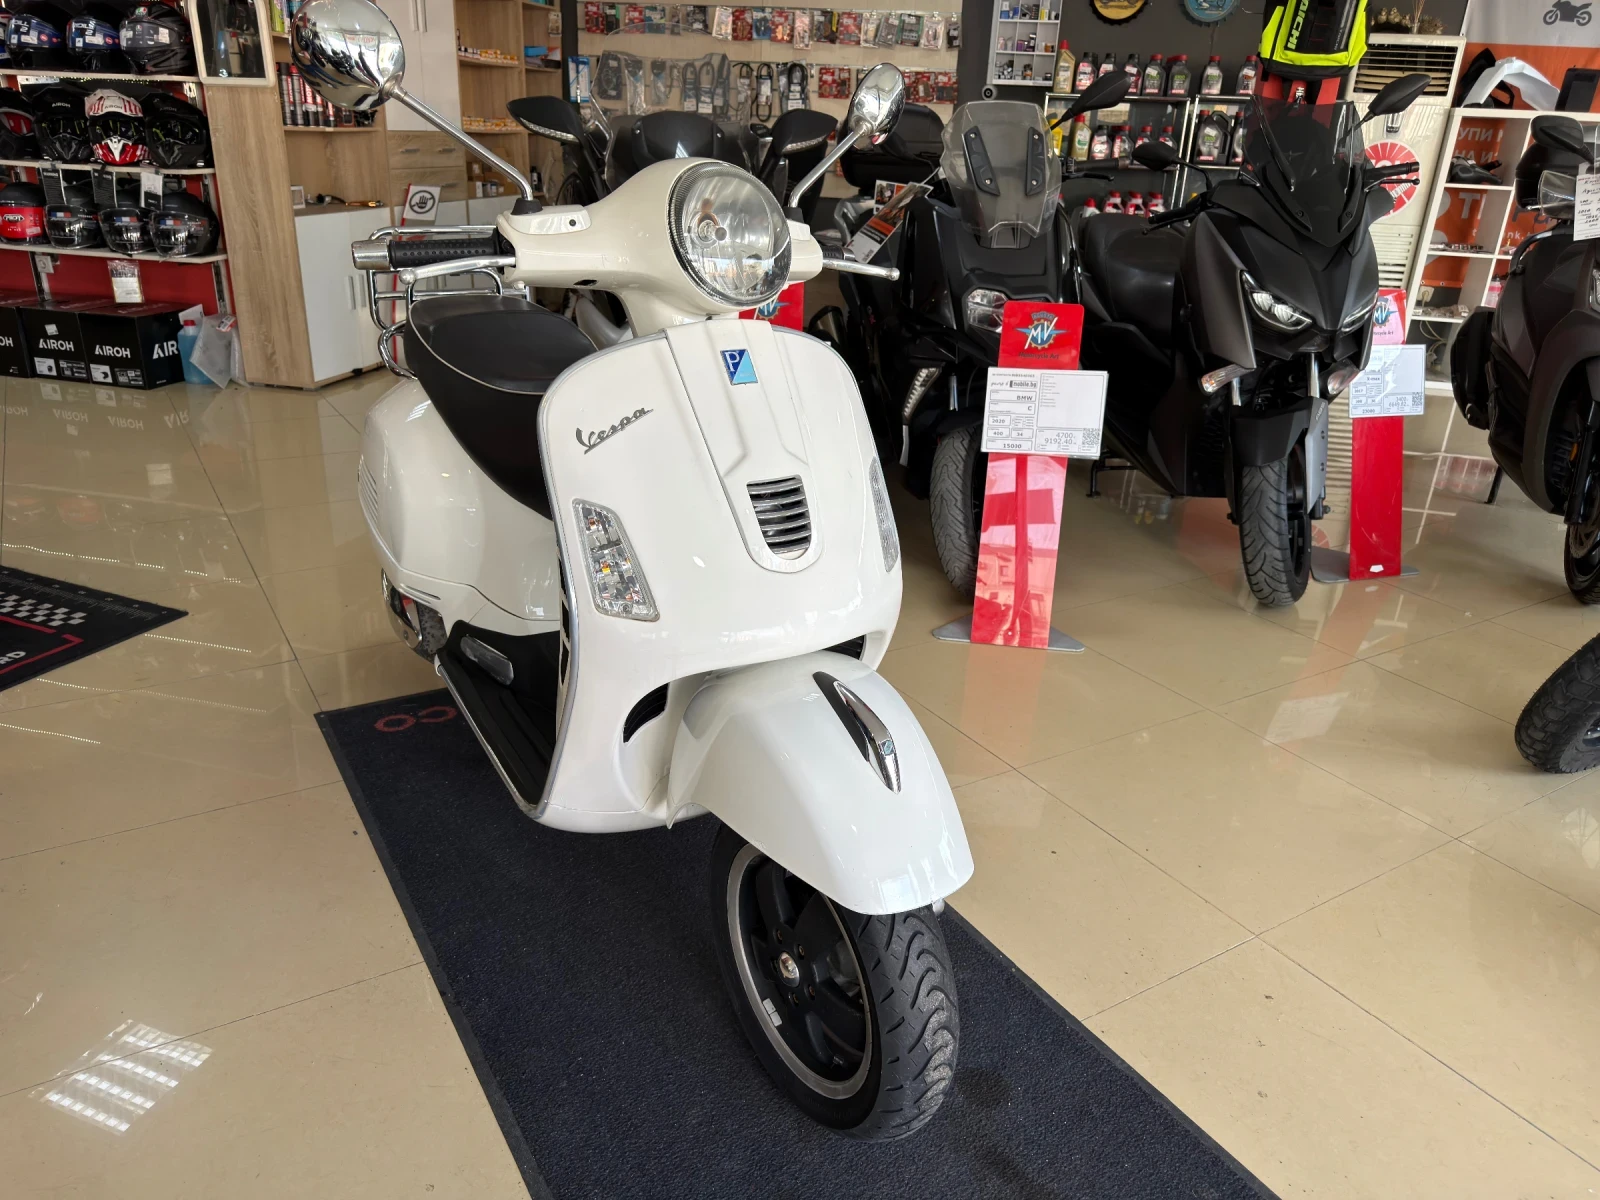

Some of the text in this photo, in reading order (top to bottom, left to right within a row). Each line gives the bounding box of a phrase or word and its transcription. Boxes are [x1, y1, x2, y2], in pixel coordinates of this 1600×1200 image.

[1458, 127, 1493, 142] УПИ
[1024, 316, 1059, 350] MV
[39, 338, 75, 352] AIROH
[95, 344, 131, 359] AIROH
[575, 407, 654, 455] Vespa
